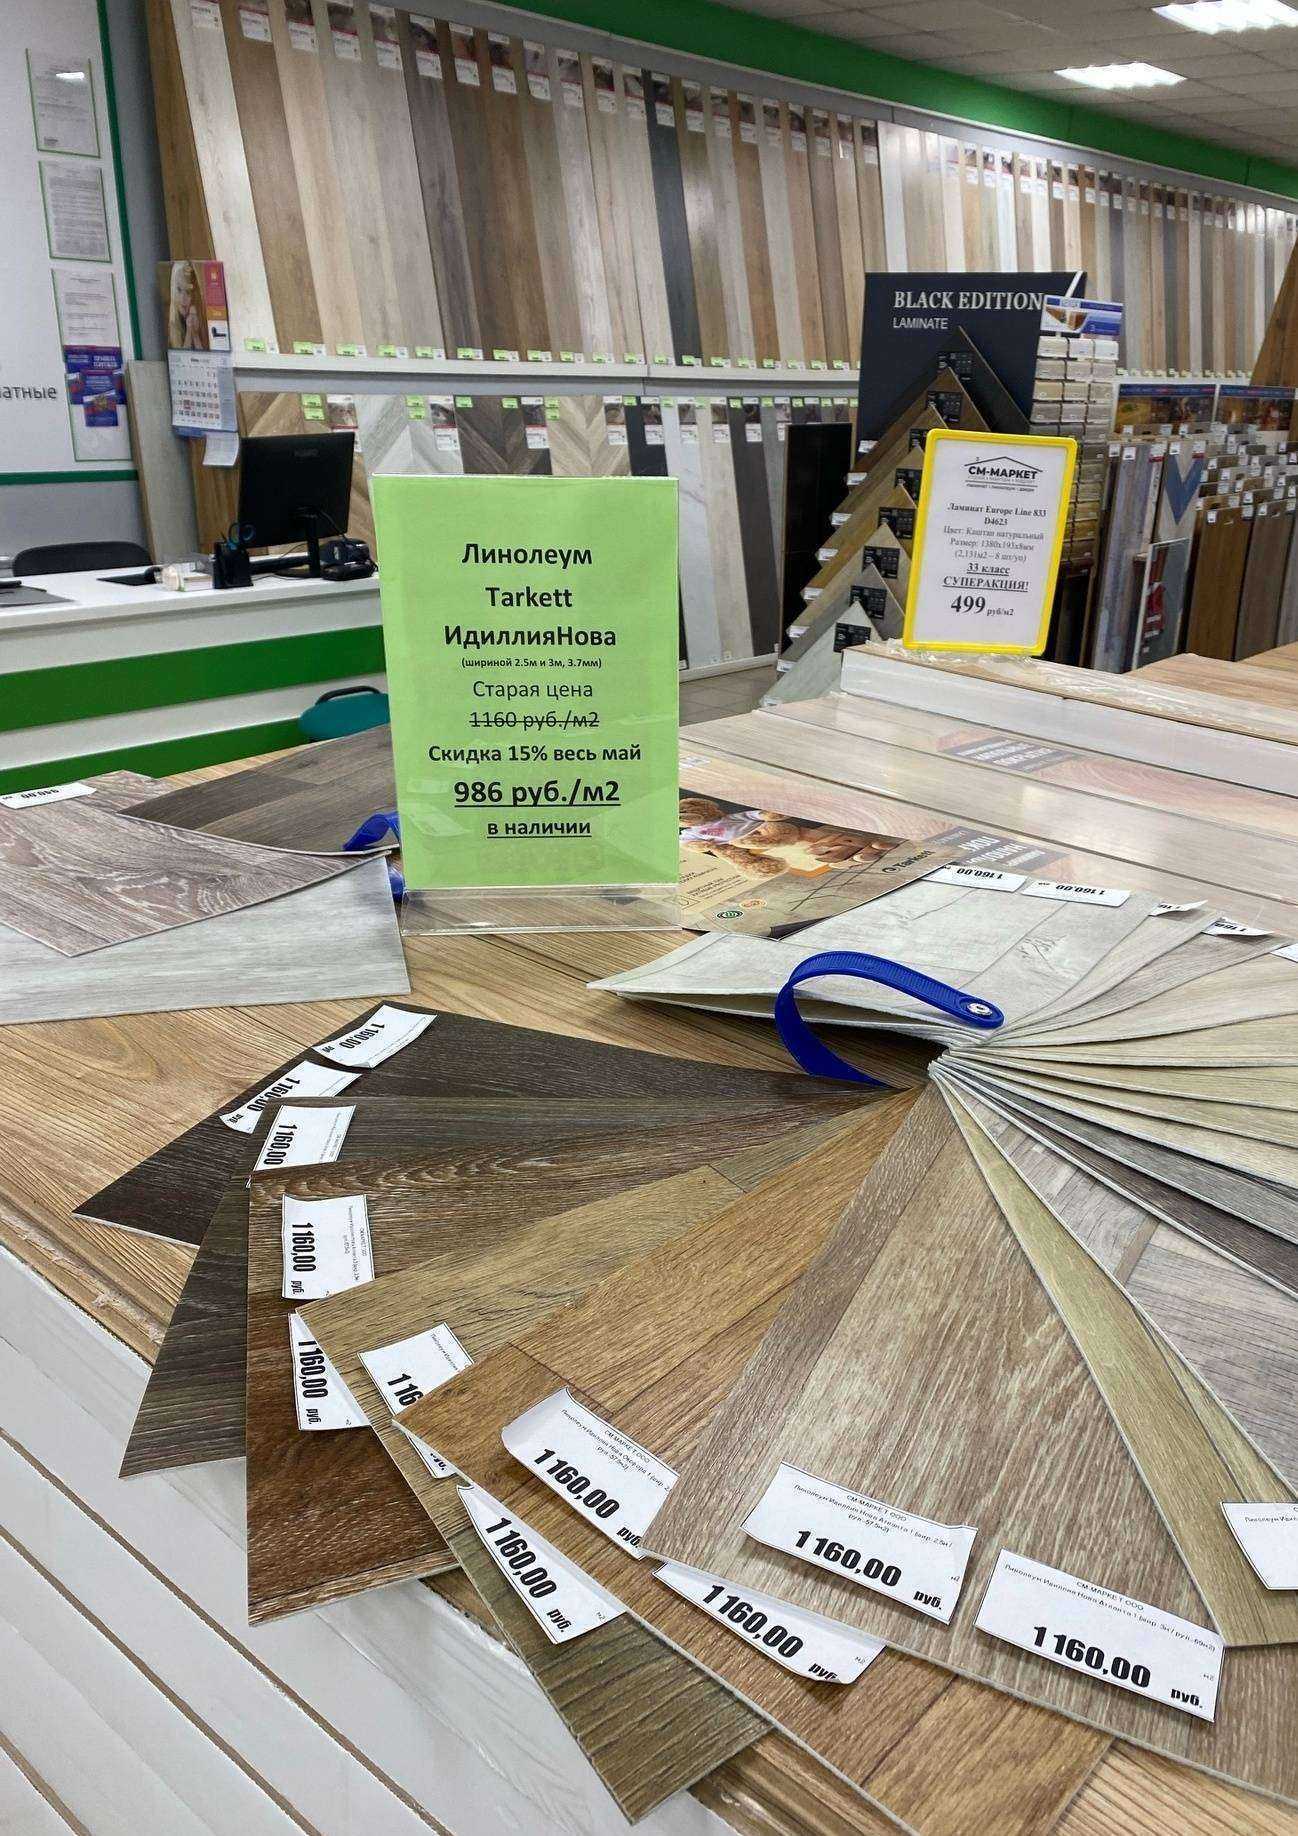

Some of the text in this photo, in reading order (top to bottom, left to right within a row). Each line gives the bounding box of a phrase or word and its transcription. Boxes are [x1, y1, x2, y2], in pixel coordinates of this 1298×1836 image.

[893, 291, 954, 309] BLACK
[958, 292, 1044, 310] EDITION
[892, 317, 949, 330] LAMINATE
[0, 386, 57, 400] атные
[968, 466, 1038, 480] СМ-МАРКЕТ
[985, 505, 1013, 515] Europe
[1014, 506, 1032, 516] Line
[462, 543, 593, 569] Линолеум
[967, 563, 1011, 574] 33 класс
[943, 575, 1030, 591] СУПЕРАКЦИЯ!
[485, 586, 573, 607] Tarkett
[950, 594, 986, 614] 499
[444, 625, 616, 649] ИдиллияНова
[461, 657, 512, 669] (шириной
[514, 658, 538, 667] 2.5м
[548, 658, 566, 668] 3м,
[567, 658, 602, 669] 3.7мм)
[473, 681, 593, 700] Старая цена
[469, 710, 600, 731] 1160 руб./м2
[428, 743, 641, 764] Скидка 15% весь май
[454, 778, 621, 807] 986 руб./м2
[487, 821, 591, 835] в наличии
[913, 1590, 942, 1610] руб.
[546, 1608, 572, 1633] руб.
[1170, 1687, 1203, 1709] руб.
